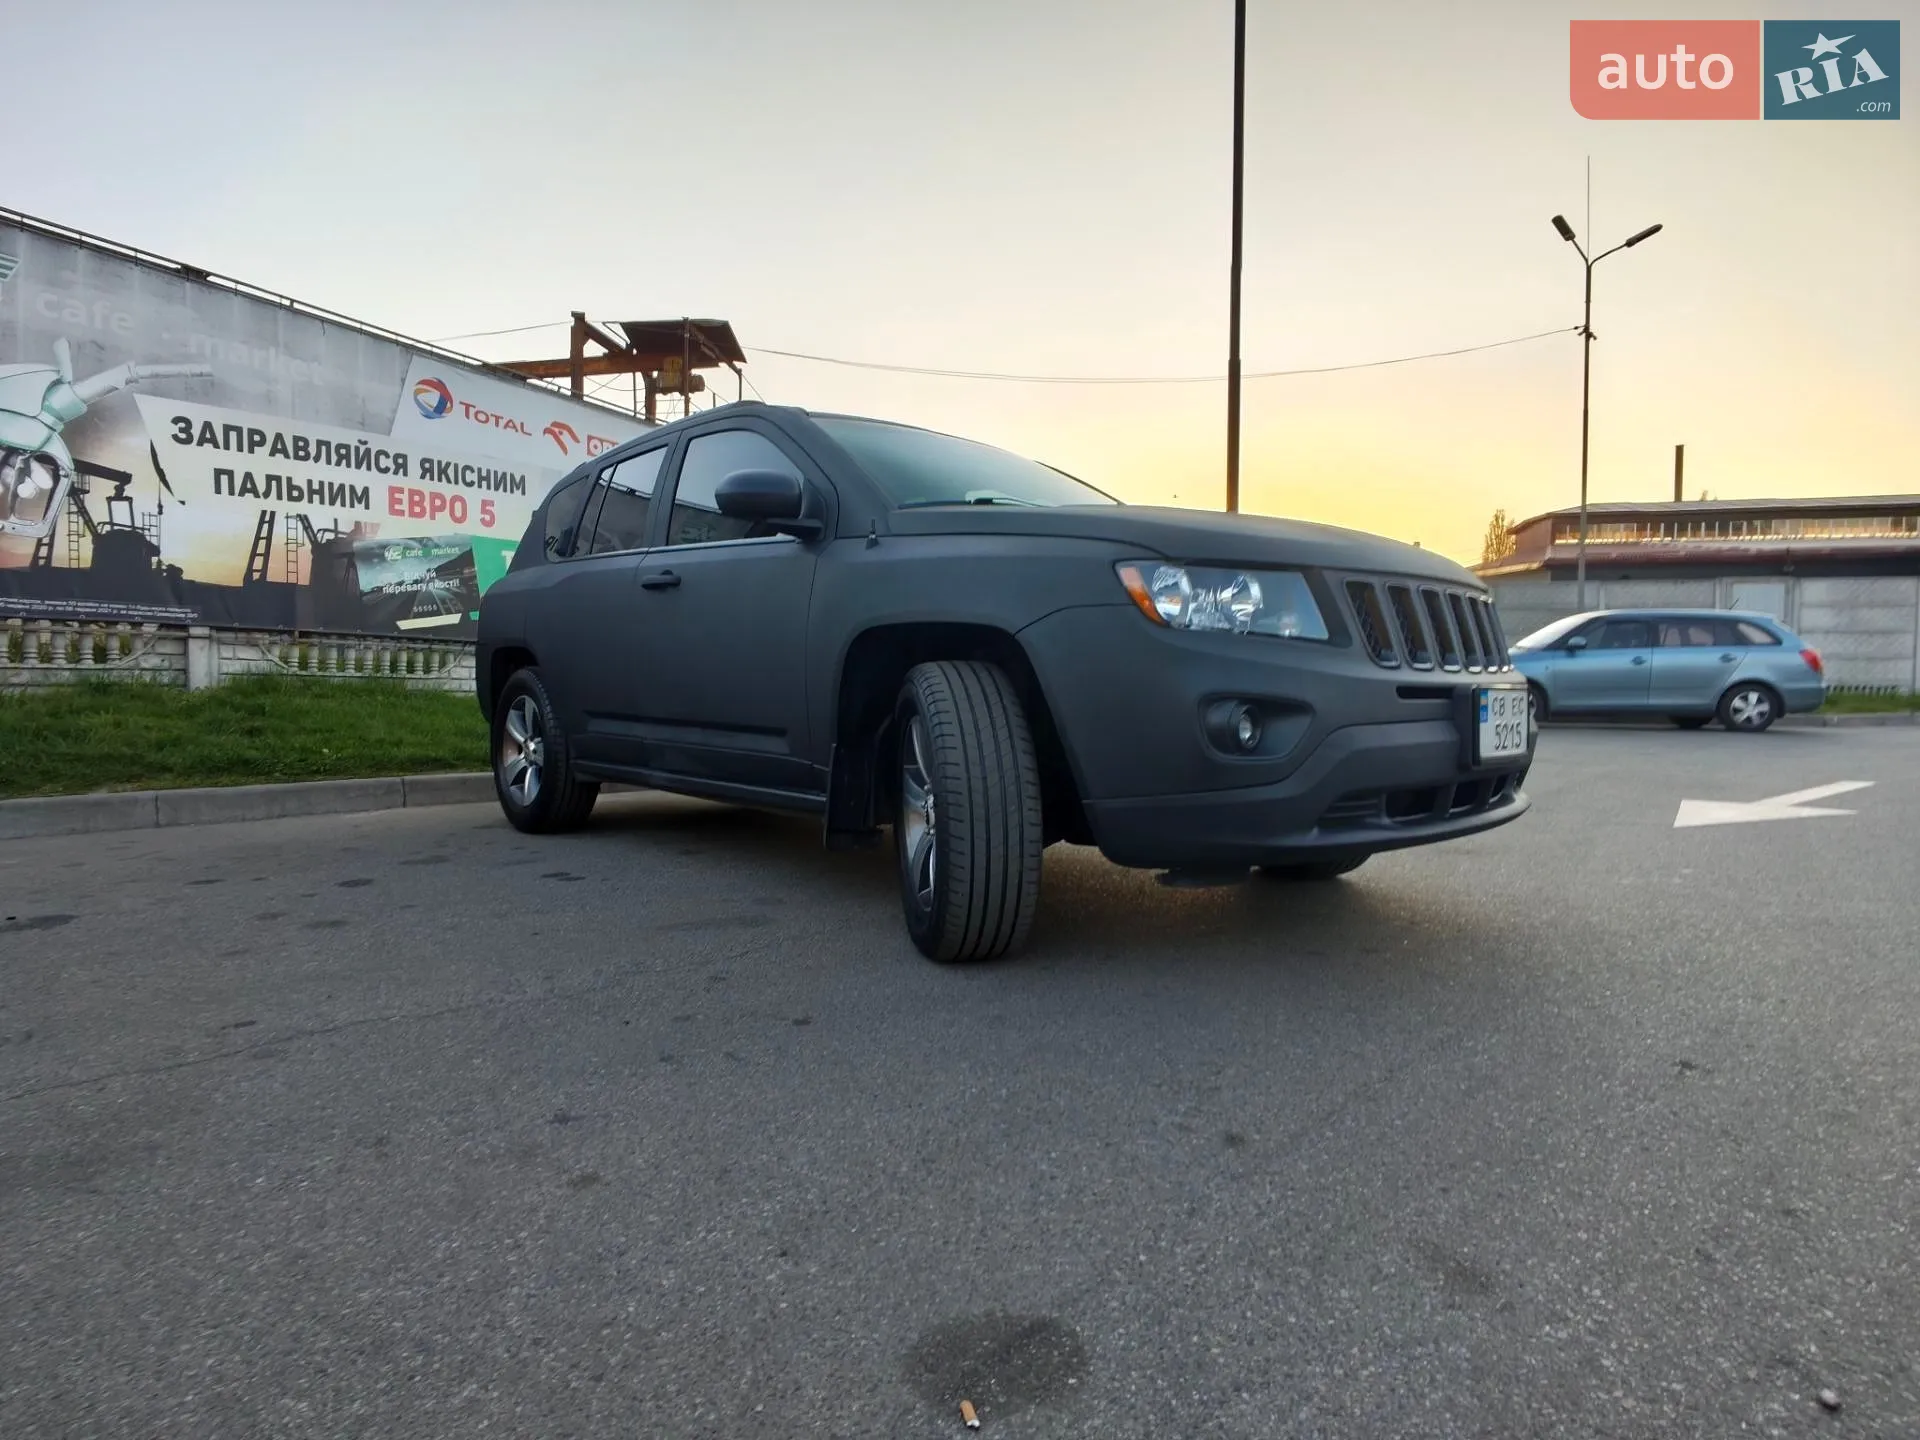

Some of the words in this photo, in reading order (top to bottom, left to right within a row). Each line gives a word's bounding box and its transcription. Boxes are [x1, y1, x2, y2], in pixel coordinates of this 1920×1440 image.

[36, 291, 136, 336] cafe
[458, 400, 533, 437] TOTAL
[170, 415, 409, 478] ЗАПРАВЛЯЙСЯ
[419, 456, 527, 497] ЯКІСНИМ
[213, 467, 371, 511] ПАЛЬНИМ
[387, 484, 469, 525] ЕВРО
[479, 498, 496, 529] 5
[1494, 721, 1523, 751] 5215
